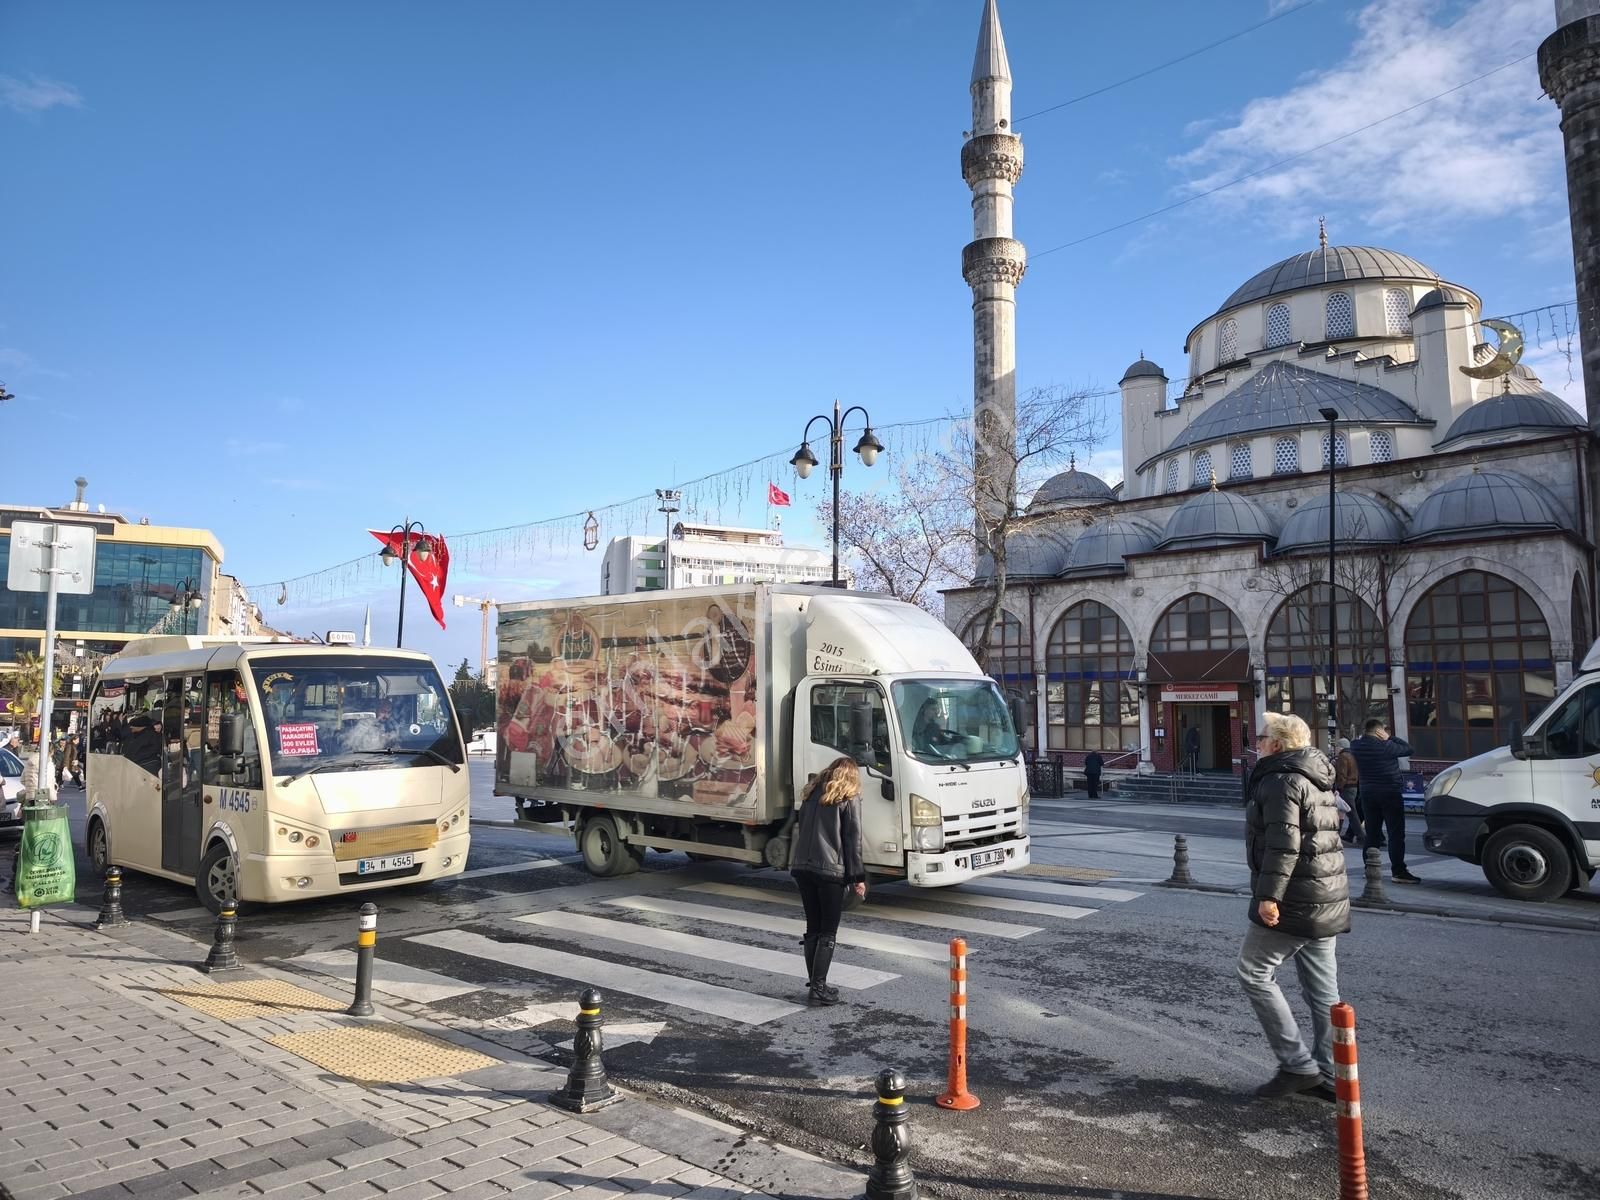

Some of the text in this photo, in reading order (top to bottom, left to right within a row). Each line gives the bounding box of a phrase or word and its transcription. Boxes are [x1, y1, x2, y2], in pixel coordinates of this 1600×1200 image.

[820, 642, 844, 657] 2015
[813, 655, 842, 673] Esinti
[282, 732, 314, 740] KARADENİZ
[219, 788, 227, 809] M
[229, 789, 250, 813] 4545
[971, 798, 996, 809] ISUZU
[365, 856, 411, 871] 34 M 4545
[975, 854, 982, 865] 59
